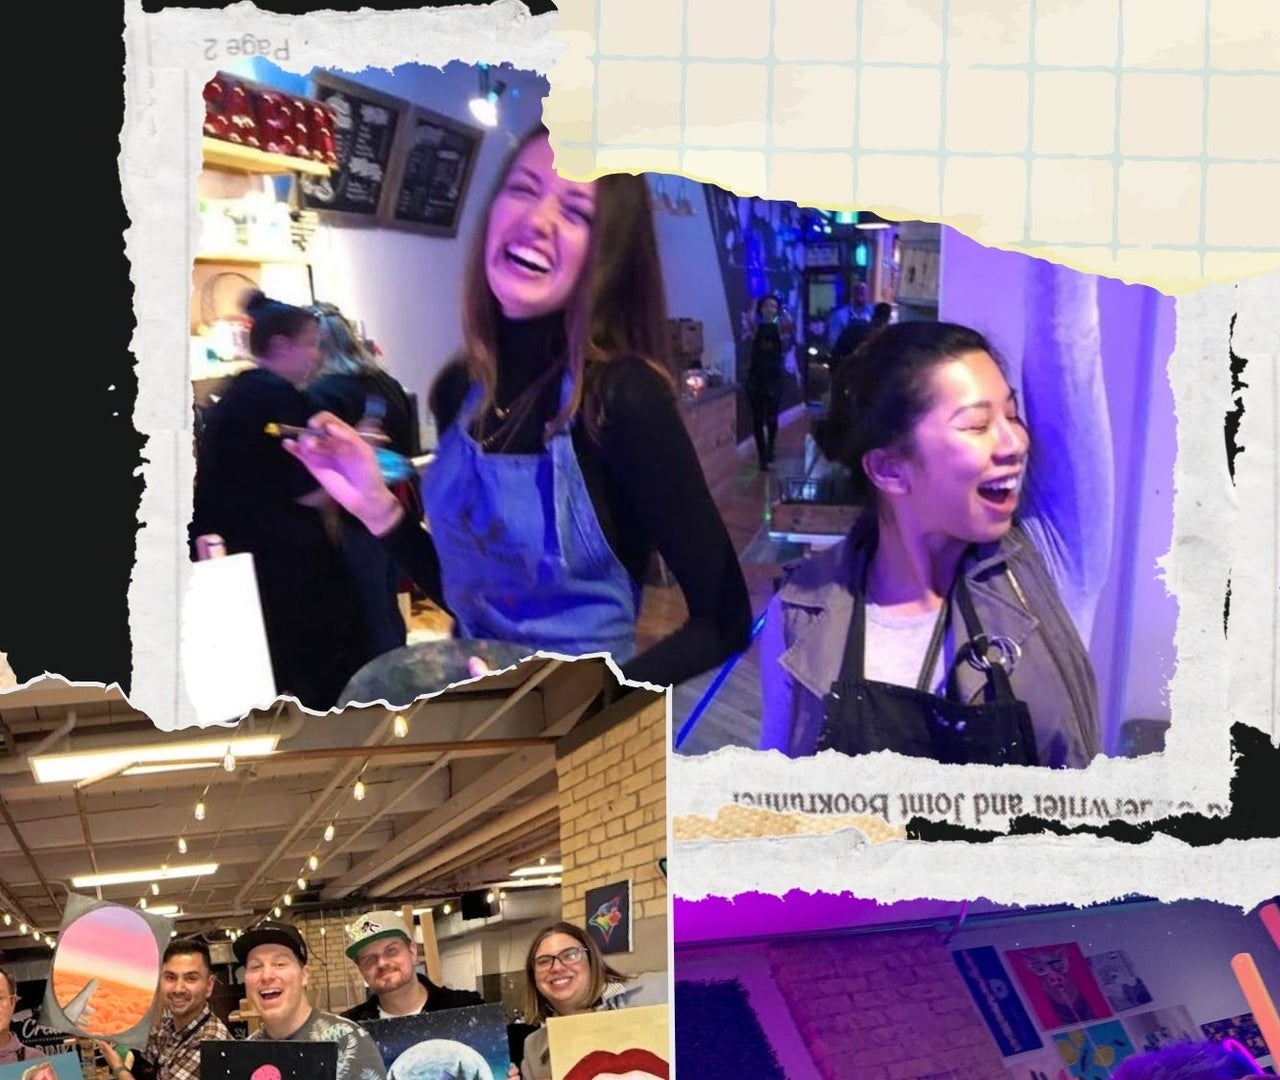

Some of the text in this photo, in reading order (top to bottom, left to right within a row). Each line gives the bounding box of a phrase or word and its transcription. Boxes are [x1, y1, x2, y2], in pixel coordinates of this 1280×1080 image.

[204, 33, 289, 60] Page 2
[973, 792, 1023, 824] and
